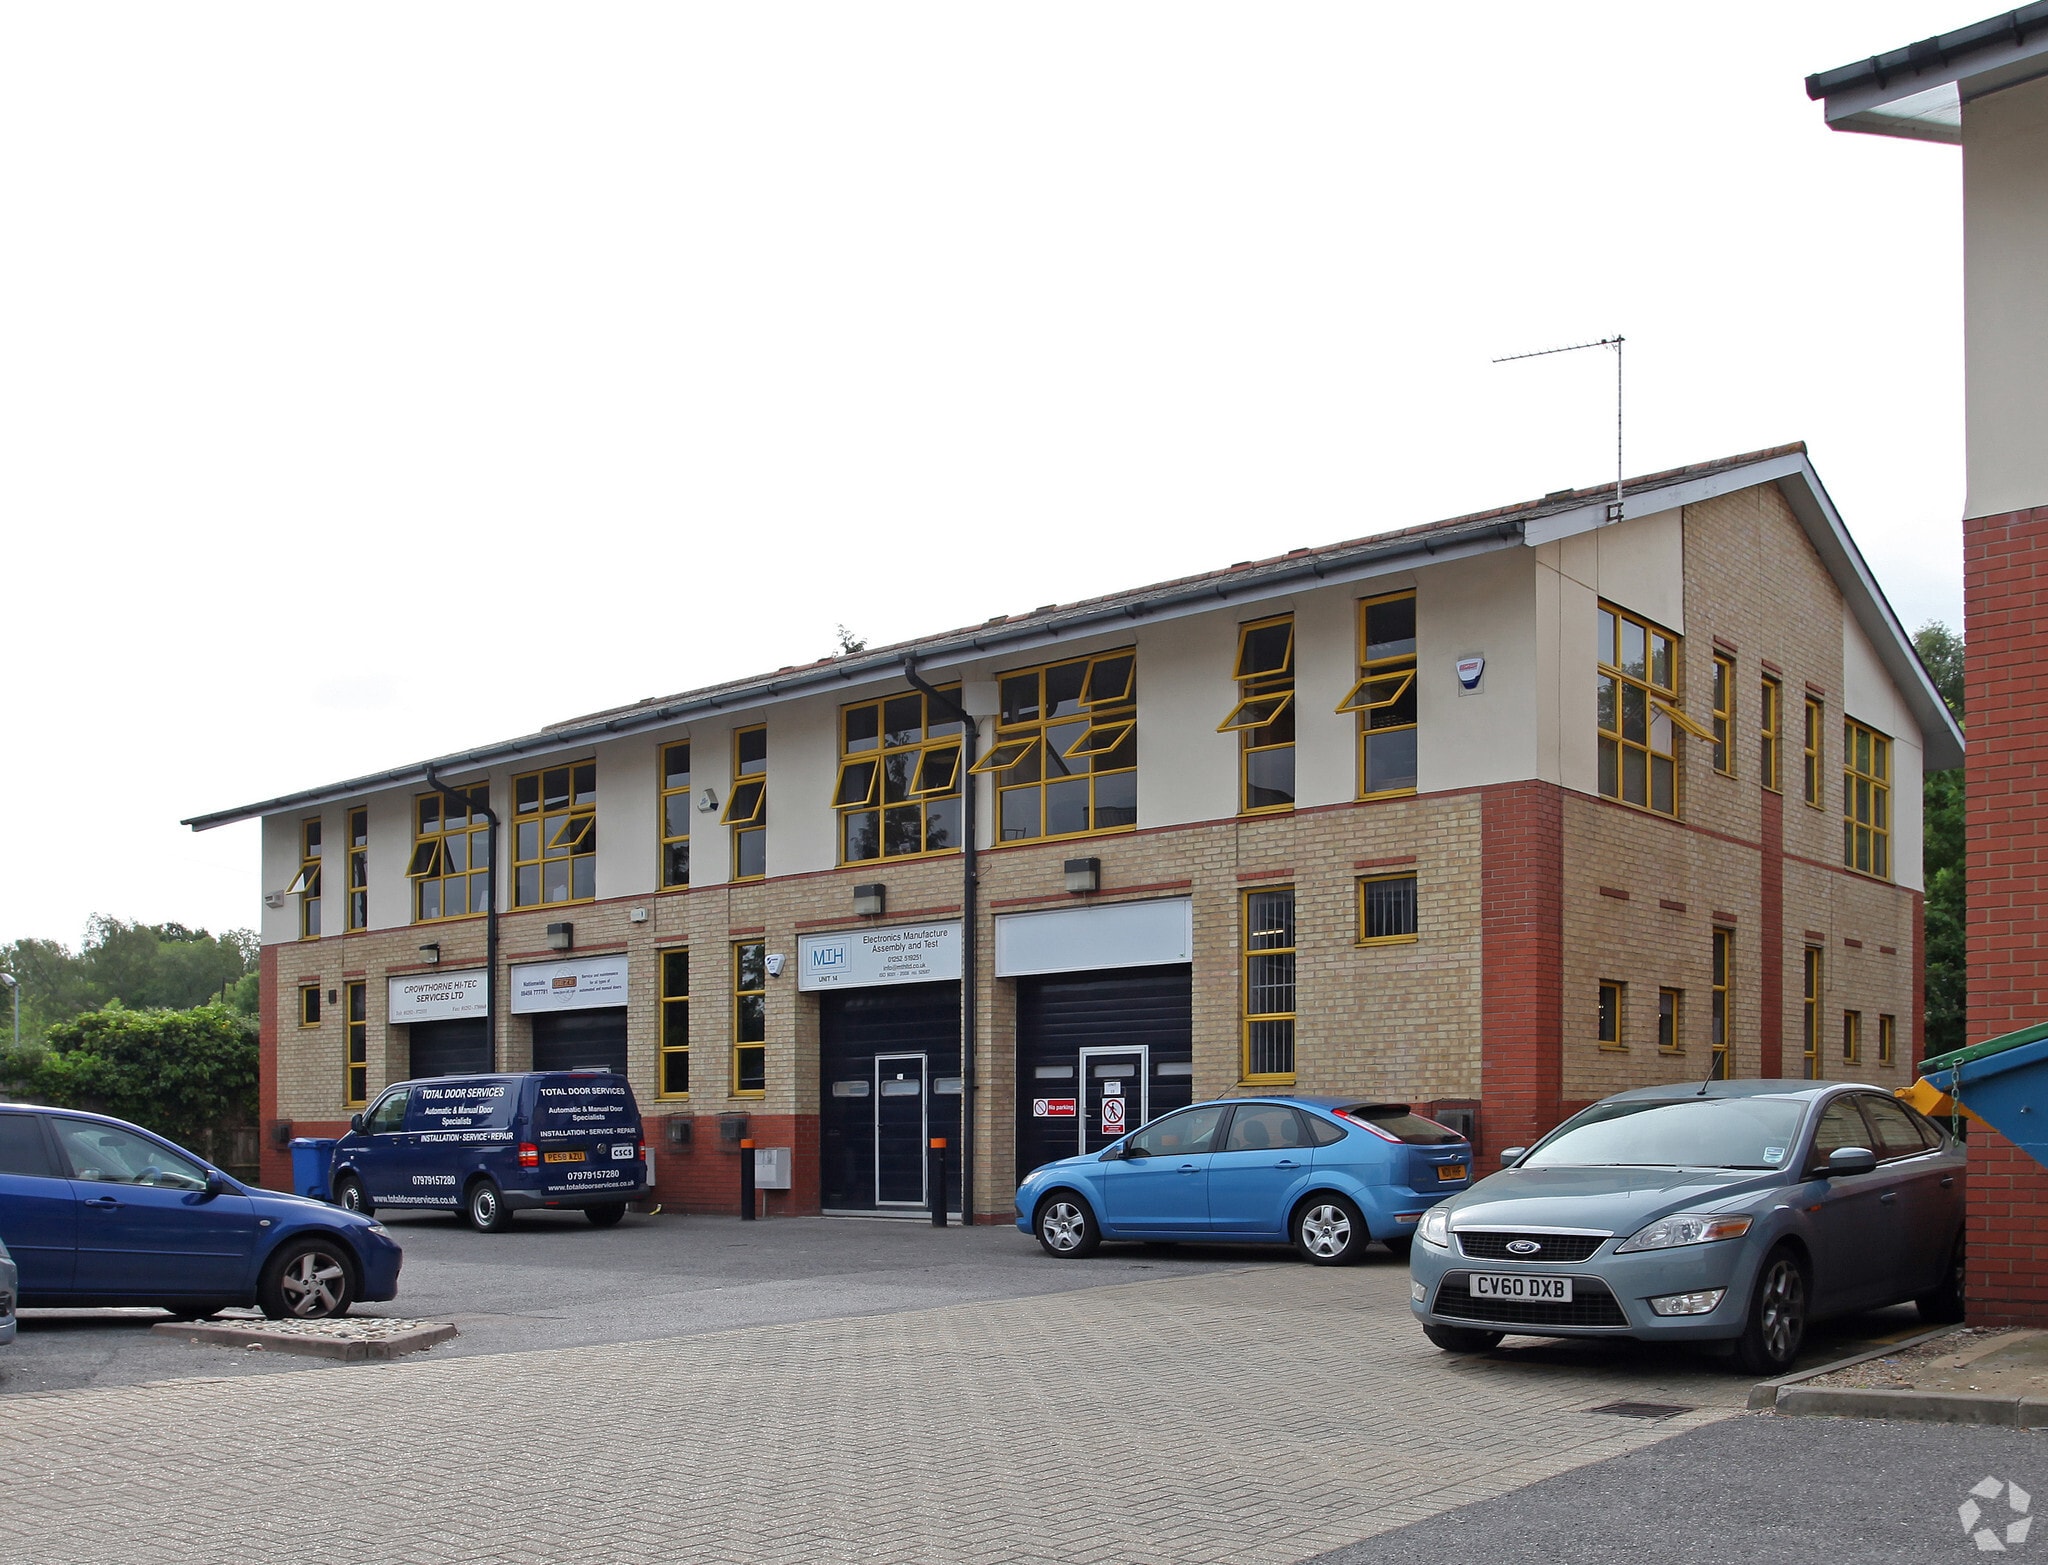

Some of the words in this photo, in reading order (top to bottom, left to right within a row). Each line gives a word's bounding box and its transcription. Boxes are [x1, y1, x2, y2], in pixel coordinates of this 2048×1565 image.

[863, 935, 900, 944] Electronics
[904, 929, 948, 940] Manufacture
[872, 943, 905, 953] Assembly
[908, 941, 922, 950] and
[814, 948, 843, 966] MTH
[404, 982, 452, 994] CROWTHORNE
[454, 980, 477, 989] HI-TEC
[416, 992, 449, 1002] SERVICES
[451, 991, 464, 1000] LTD
[422, 1090, 443, 1099] TOTAL
[445, 1088, 466, 1098] DOOR
[467, 1087, 504, 1098] SERVICES
[540, 1088, 567, 1096] TOTAL
[458, 1105, 478, 1114] Manual
[442, 1117, 472, 1126] Specialists
[421, 1134, 460, 1142] INSTALLATION
[462, 1132, 487, 1141] SERVICE
[490, 1132, 514, 1140] REPAIR
[412, 1176, 456, 1185] 07979157280
[567, 1170, 619, 1180] 07979157280
[548, 1180, 634, 1191] www.totaldoorservices.co.uk
[372, 1194, 458, 1204] www.totaldoorservices.co.uk
[1478, 1277, 1524, 1296] CV60
[1529, 1279, 1564, 1298] DXB
